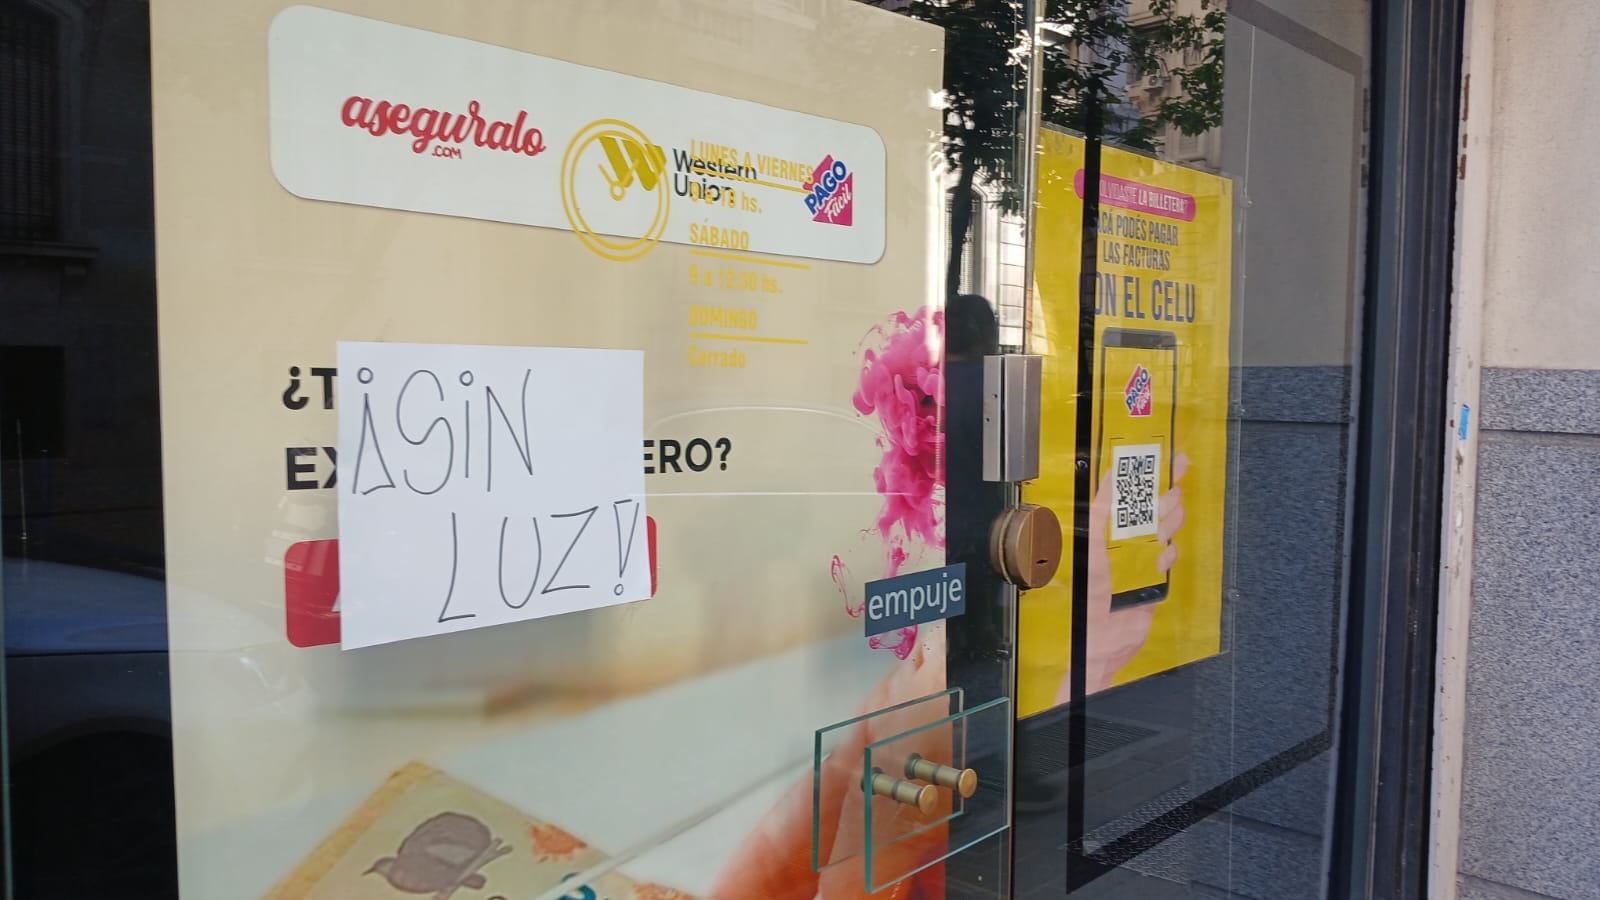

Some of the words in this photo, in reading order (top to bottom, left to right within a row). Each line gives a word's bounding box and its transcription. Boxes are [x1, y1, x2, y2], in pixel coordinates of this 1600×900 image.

[341, 95, 547, 156] aseguralo
[672, 147, 757, 181] Western
[690, 139, 738, 169] LUNES
[742, 151, 753, 171] A
[757, 154, 815, 185] VIERNES
[674, 172, 734, 202] Union
[803, 160, 847, 216] PAGO
[1138, 188, 1148, 207] LA
[689, 217, 750, 250] SÁBADO
[1116, 213, 1147, 241] PODÉS
[1149, 220, 1179, 247] PAGAR
[1103, 238, 1121, 265] LAS
[1123, 243, 1171, 272] FACTURAS
[688, 263, 699, 286] 9
[703, 270, 713, 287] a
[717, 267, 759, 292] 12:30
[761, 272, 784, 294] hs.
[1123, 274, 1146, 319] EL
[1151, 279, 1197, 324] CELU
[688, 304, 758, 331] DOMINGO
[687, 344, 747, 369] Cerrado
[437, 499, 640, 623] LUZ!
[868, 572, 962, 620] empuje
